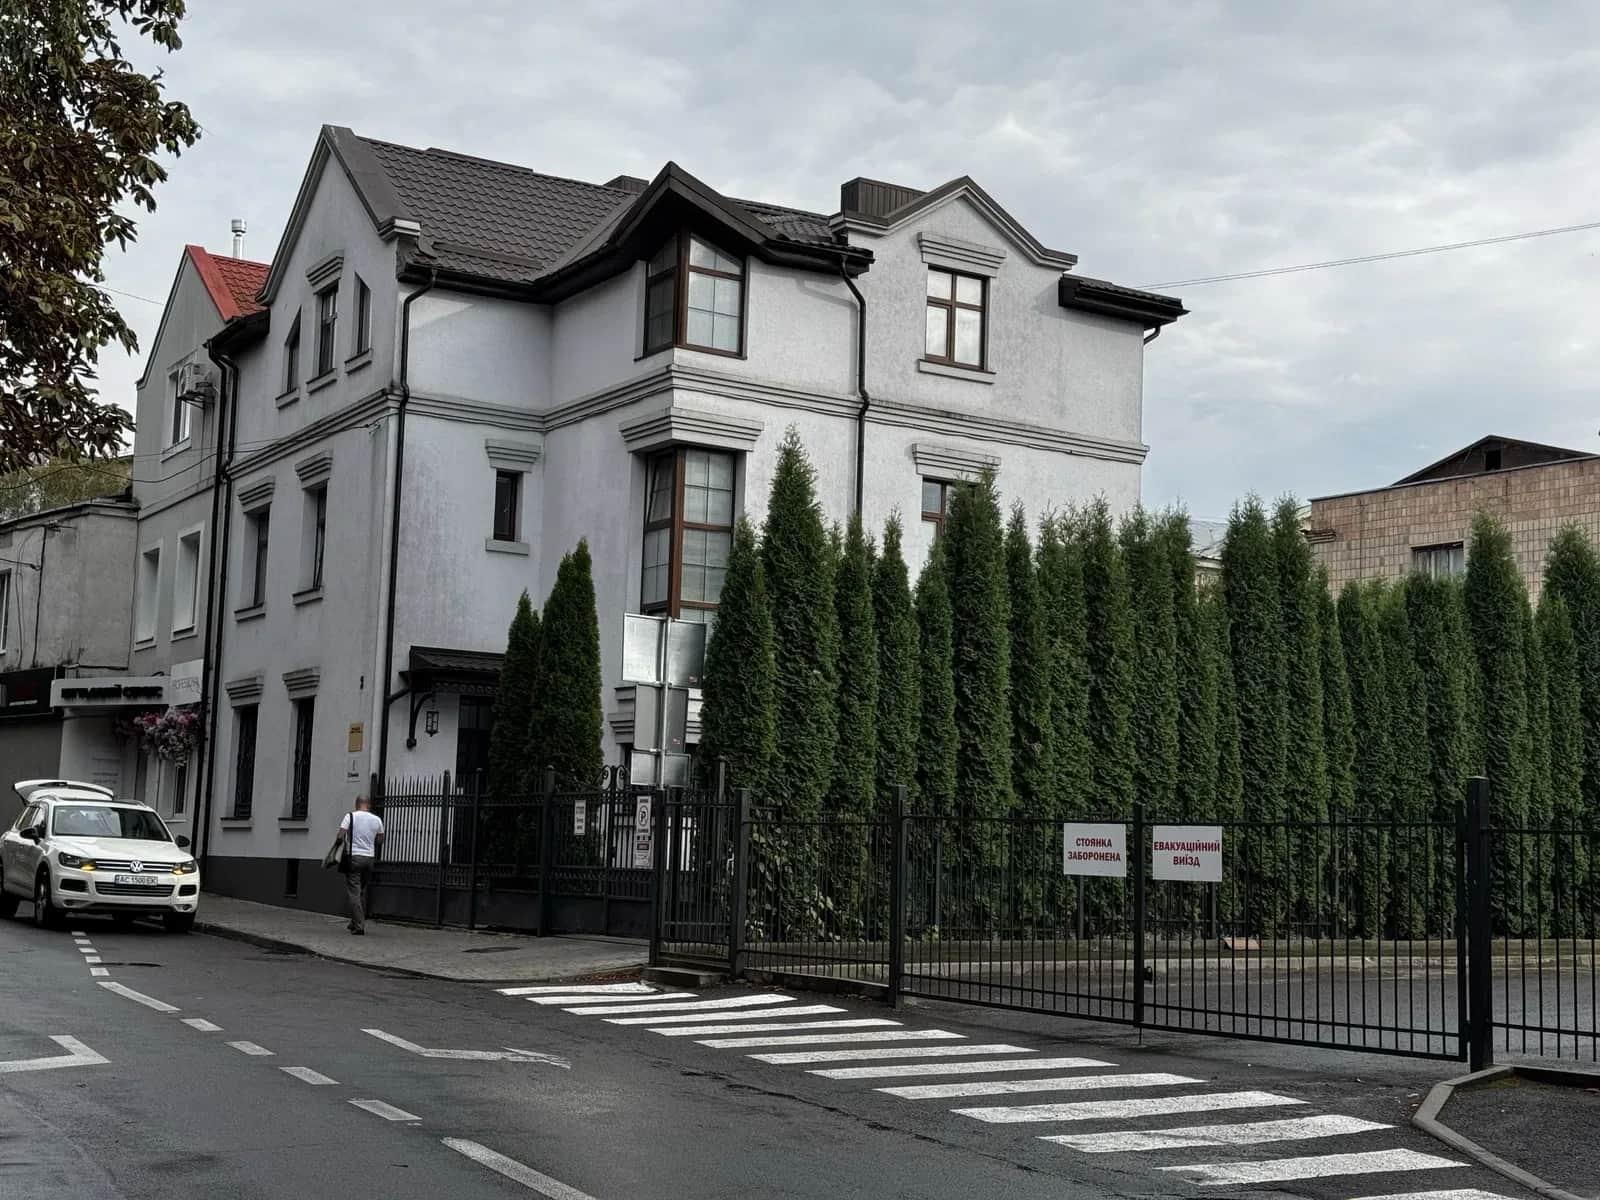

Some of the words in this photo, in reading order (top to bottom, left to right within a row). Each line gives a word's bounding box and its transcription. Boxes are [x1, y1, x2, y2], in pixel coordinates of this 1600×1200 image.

[1075, 837, 1113, 848] СТОЯНКА
[1153, 839, 1220, 853] ЕВАКУАЦІЙНИЙ
[1067, 850, 1121, 862] ЗАБОРОНЕНА
[1173, 854, 1201, 868] ВИЇЗД
